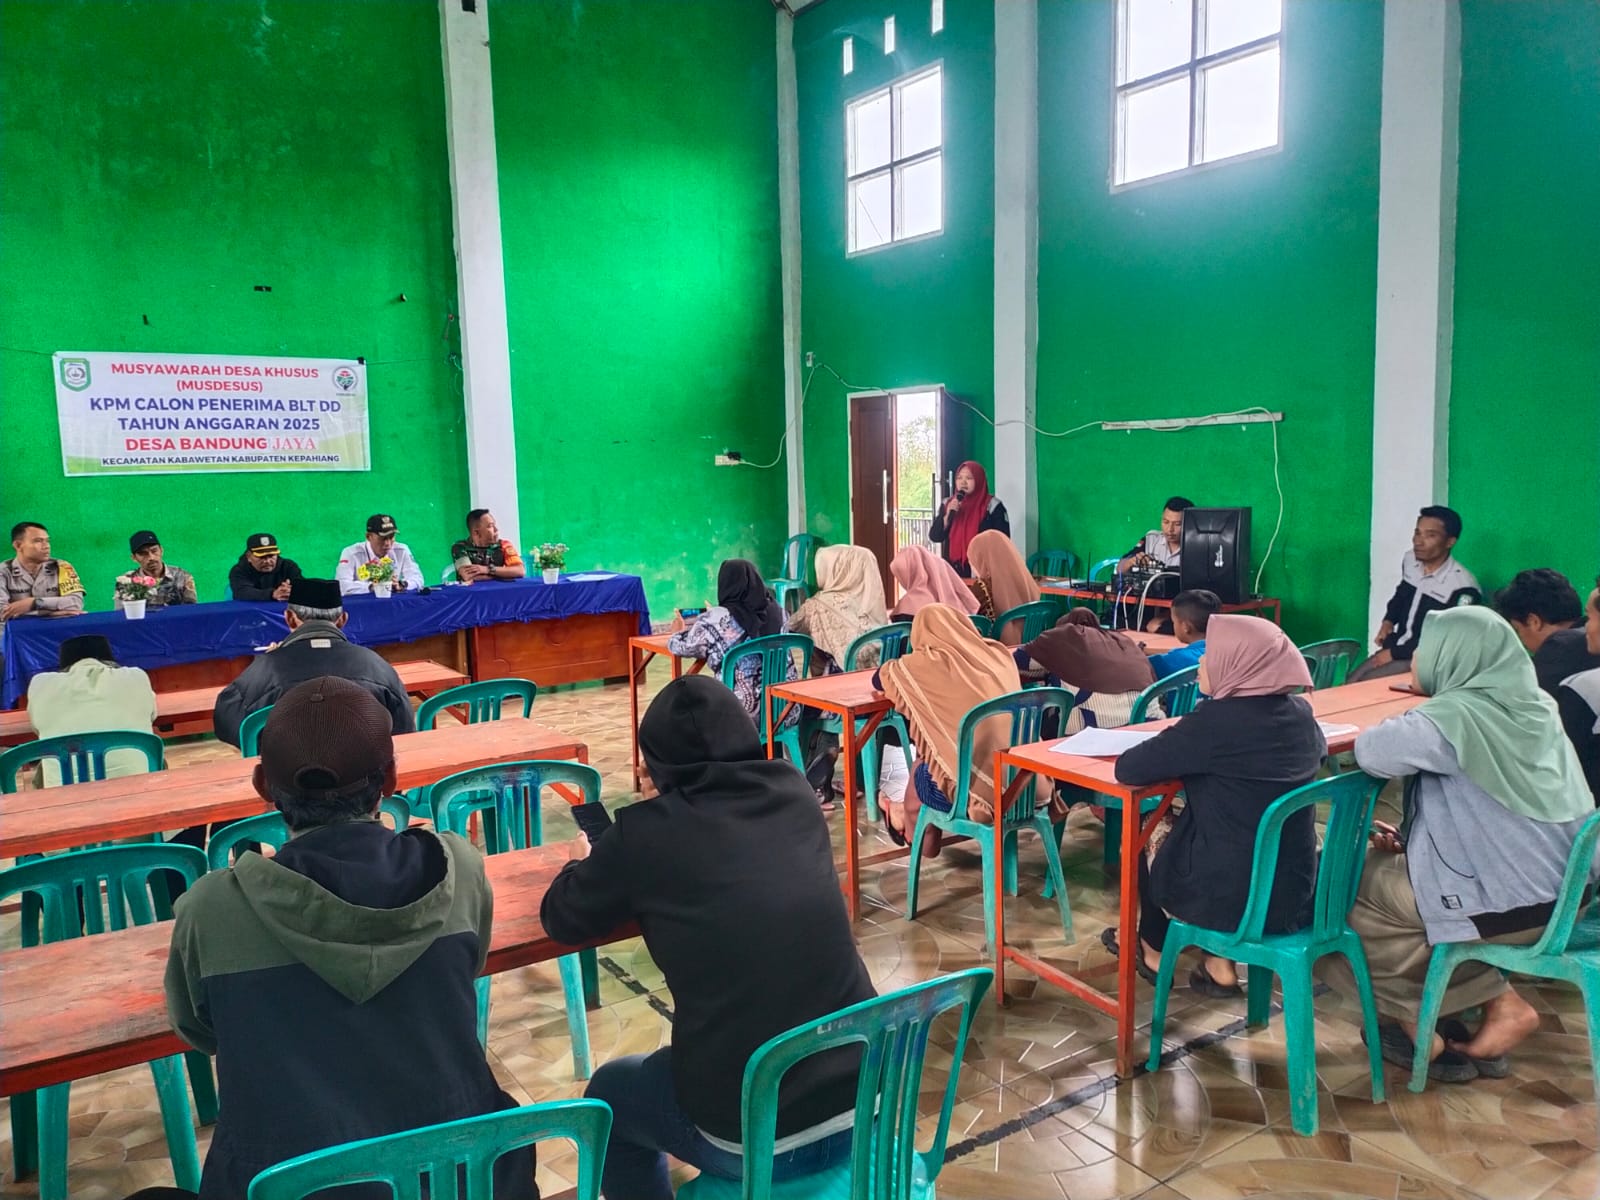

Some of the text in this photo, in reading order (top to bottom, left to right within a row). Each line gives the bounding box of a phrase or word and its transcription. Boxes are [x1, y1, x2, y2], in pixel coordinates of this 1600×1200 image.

[111, 363, 319, 378] MUSYAWARAH DESA KHUSUS
[176, 380, 263, 393] (MUSDESUS)
[90, 398, 341, 413] KPM CALON PENERIMA BLT DD
[117, 417, 320, 430] TAHUN ANGGARAN 2025
[125, 437, 317, 451] DESA BANDUNG JAYA
[102, 456, 166, 465] KECAMATAN
[167, 456, 230, 464] KABAWETAN
[231, 455, 286, 463] KABUPATEN
